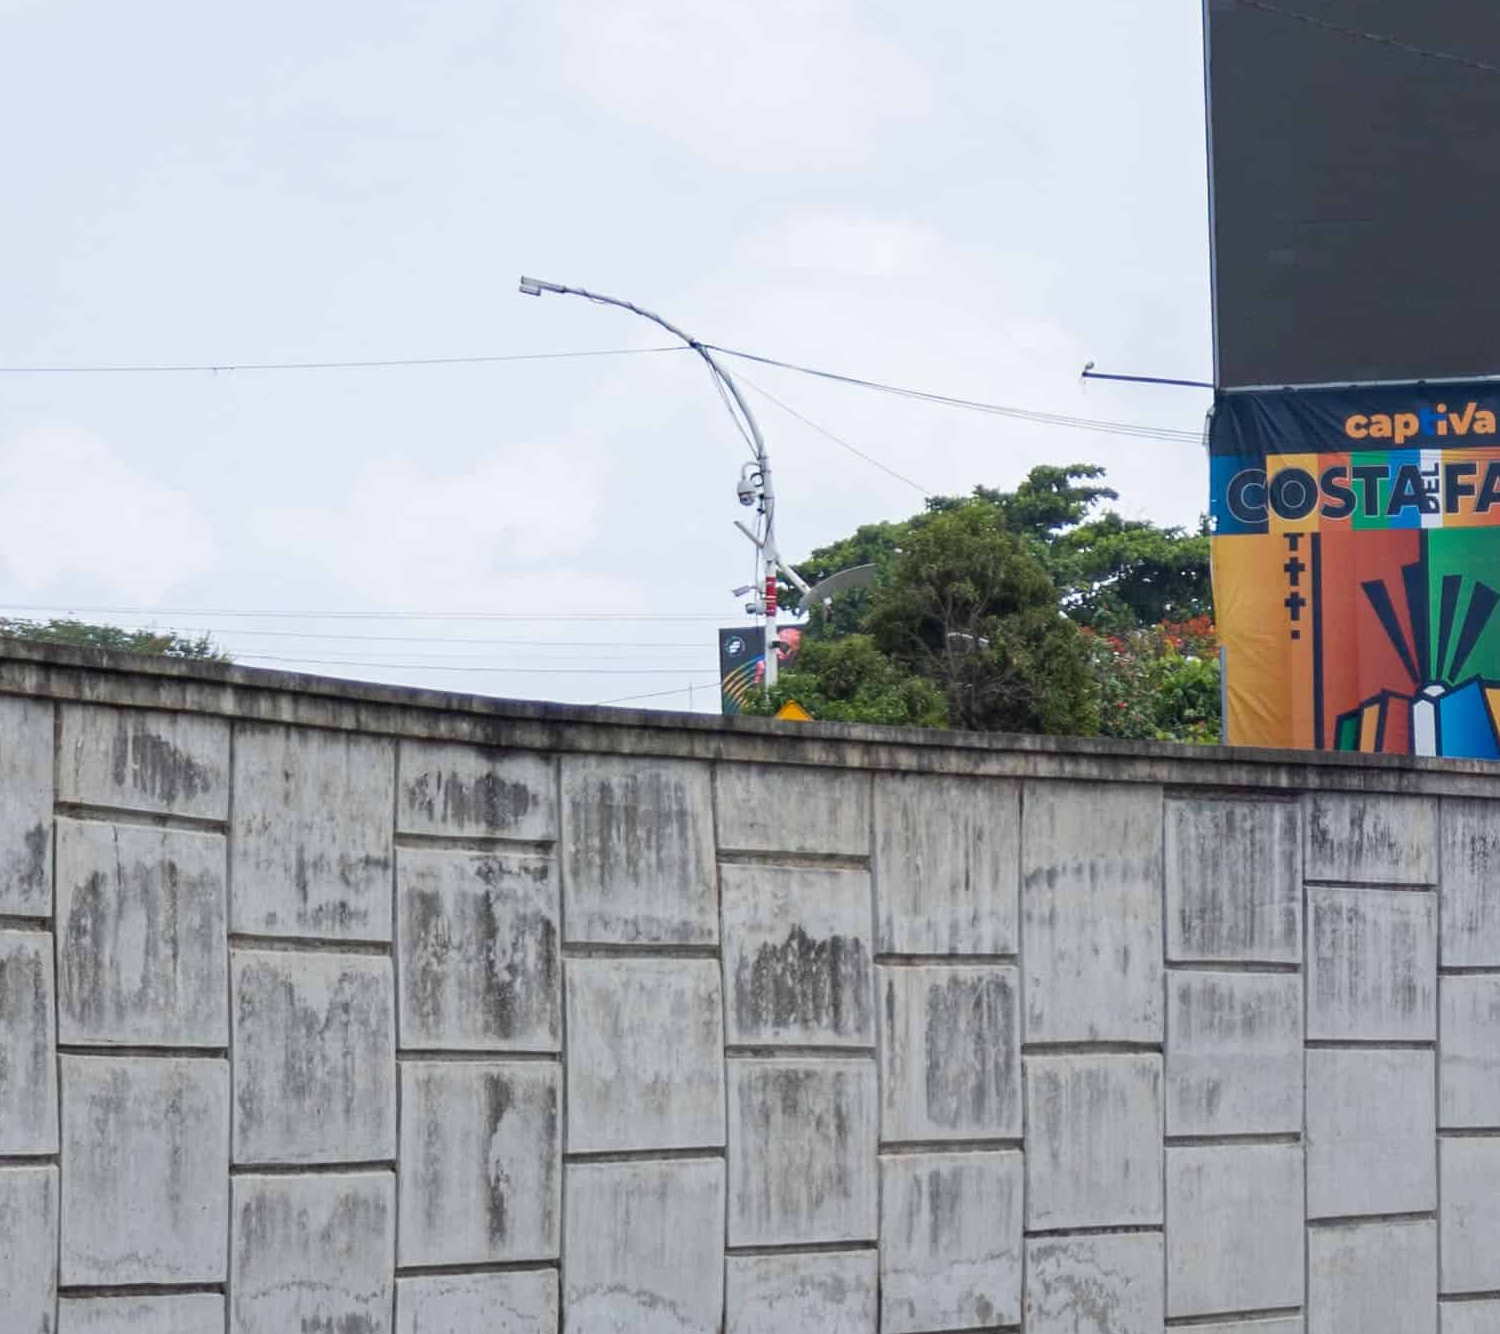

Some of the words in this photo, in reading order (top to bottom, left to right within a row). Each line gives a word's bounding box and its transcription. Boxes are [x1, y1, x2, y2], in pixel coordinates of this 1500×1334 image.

[1345, 402, 1497, 444] captiva
[1226, 463, 1422, 524] COSTA
[1420, 462, 1441, 515] DEL
